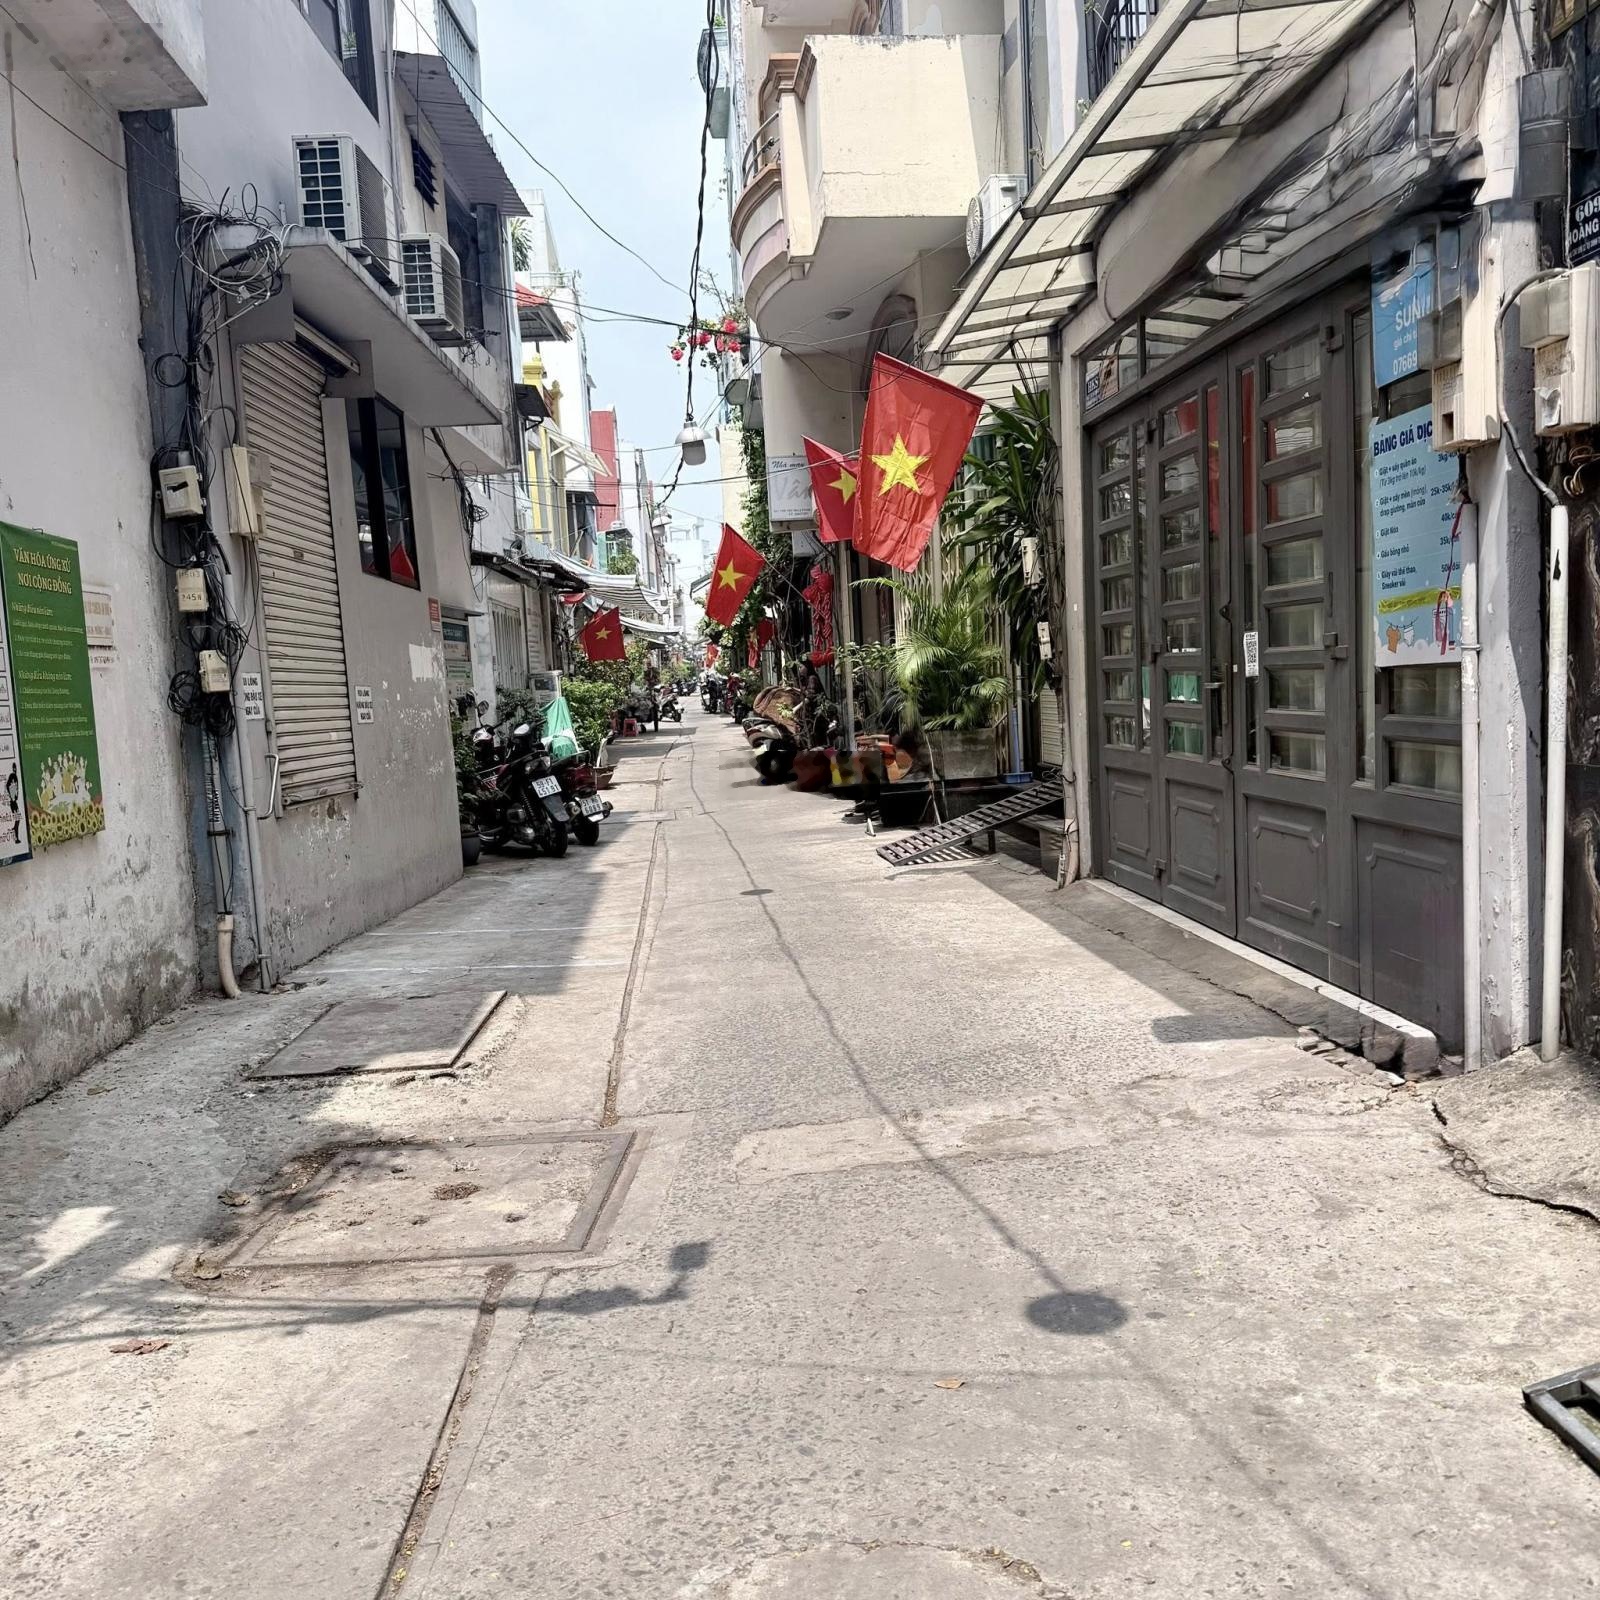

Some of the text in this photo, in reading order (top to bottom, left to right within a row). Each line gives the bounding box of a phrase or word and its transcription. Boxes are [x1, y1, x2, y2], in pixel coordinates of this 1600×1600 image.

[1373, 433, 1398, 457] BẢNG
[1399, 424, 1415, 447] GIÁ
[13, 547, 30, 564] VĂN
[30, 551, 46, 568] HÓA
[18, 572, 72, 595] NƠI CỘNG ĐỒNG
